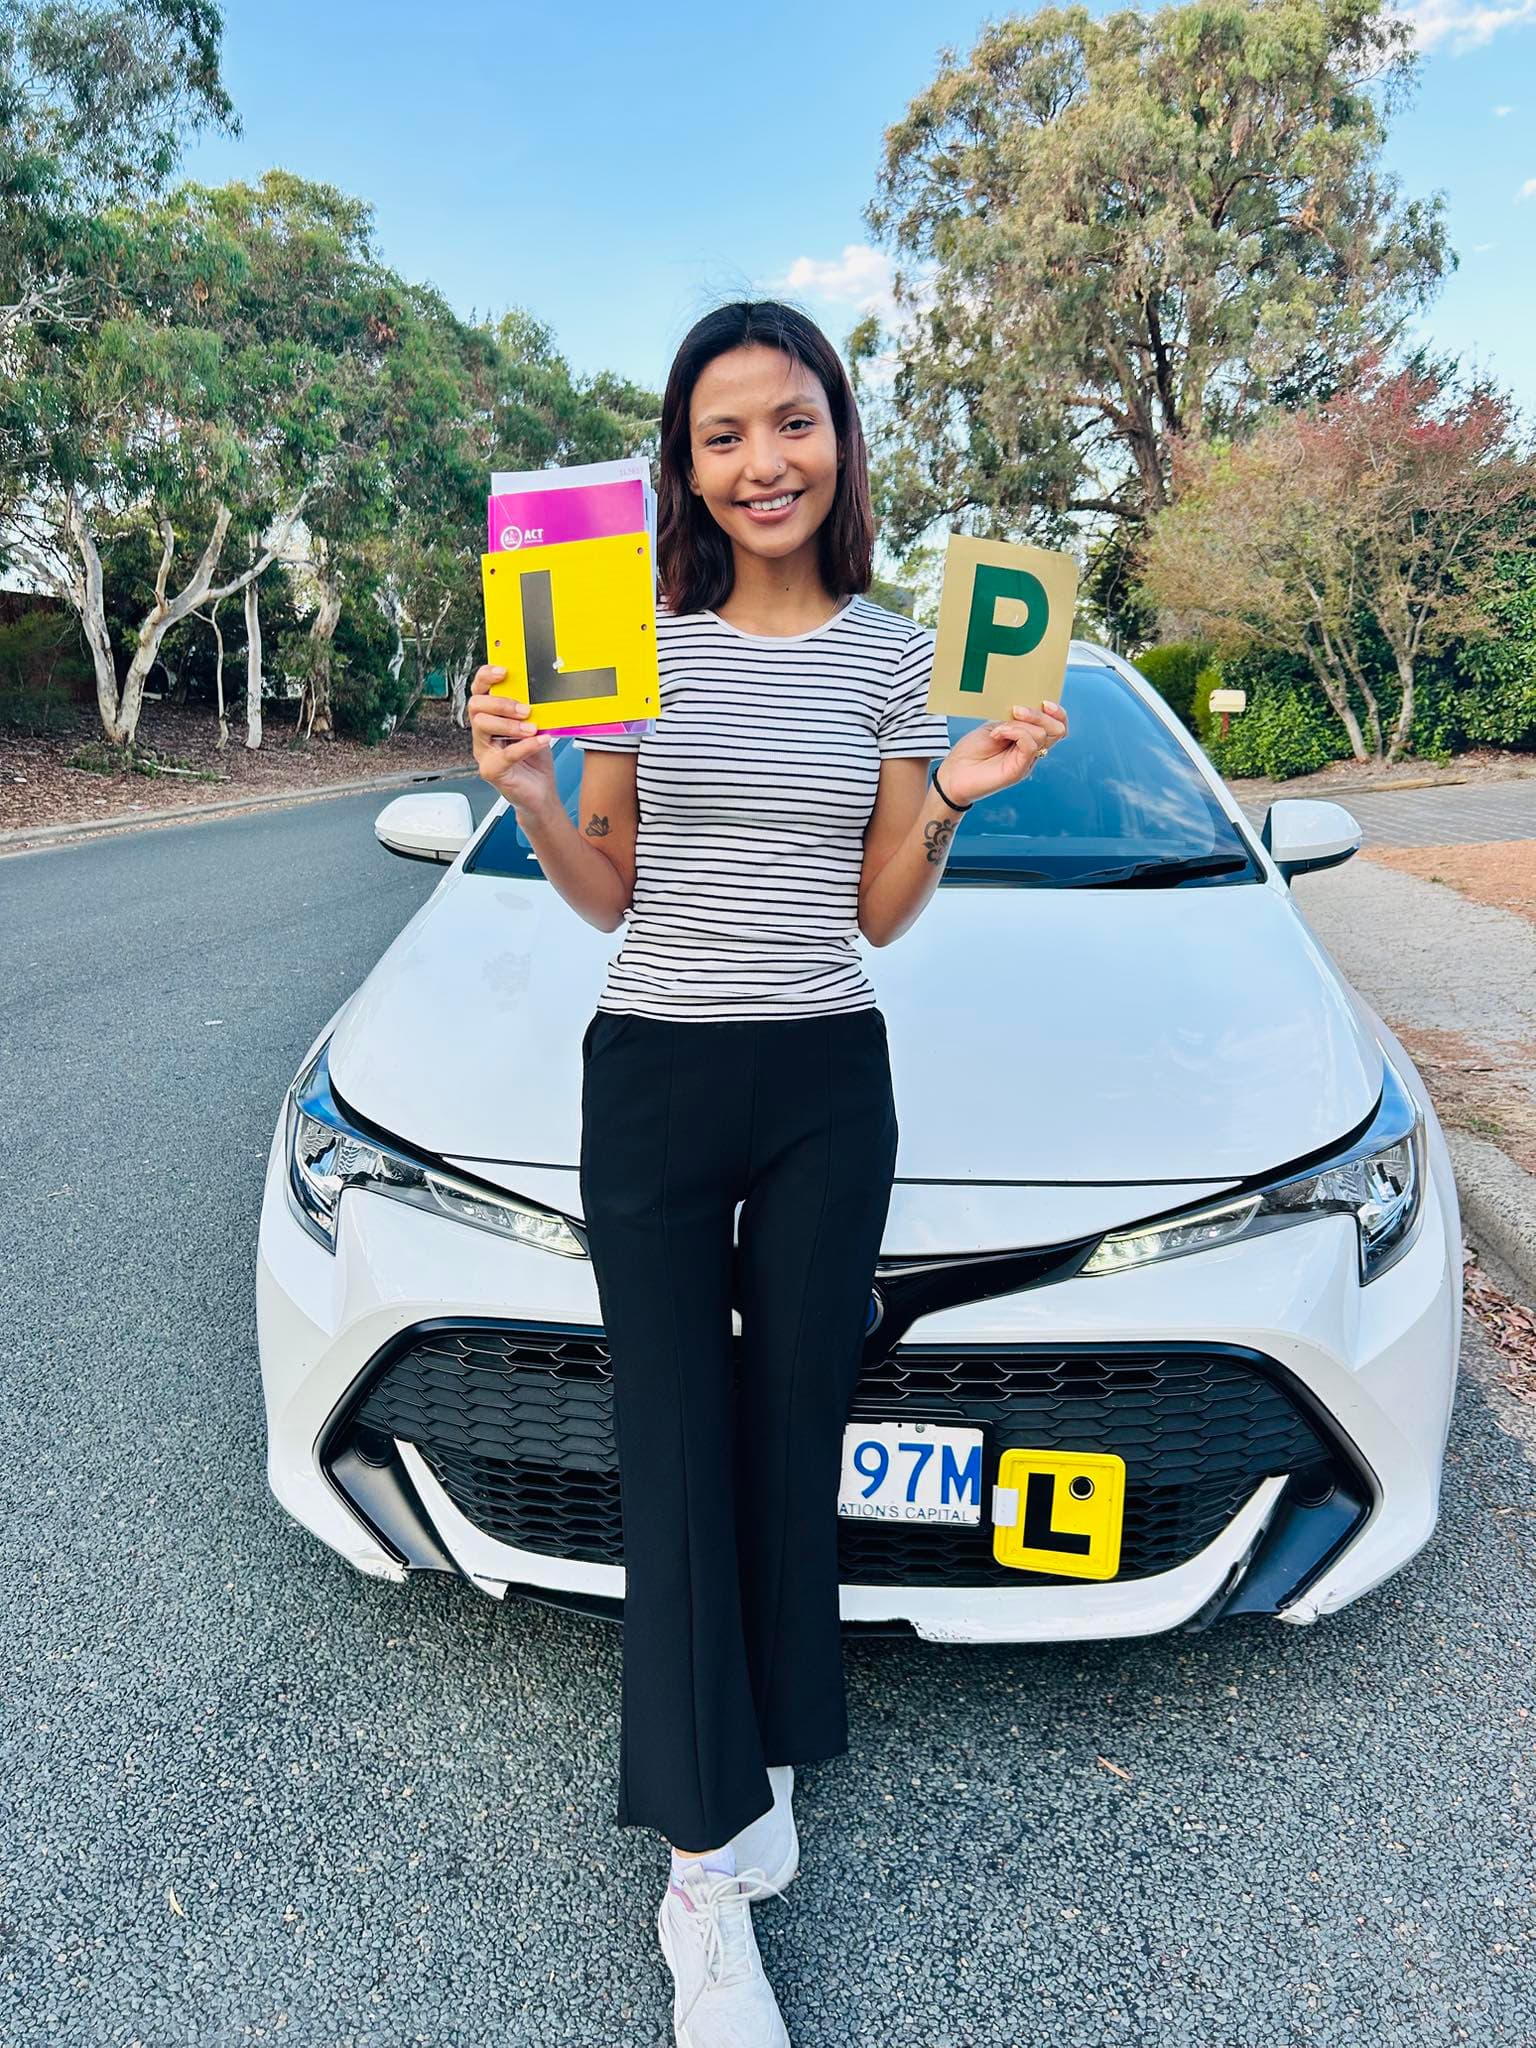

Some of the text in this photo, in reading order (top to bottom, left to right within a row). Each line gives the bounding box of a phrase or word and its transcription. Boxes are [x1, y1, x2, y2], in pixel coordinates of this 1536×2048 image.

[524, 528, 543, 539] ACT
[520, 569, 618, 704] L
[959, 563, 1049, 693] P
[854, 1441, 981, 1505] 97M
[838, 1503, 971, 1521] ATION'S CAPITAL
[1023, 1472, 1091, 1555] L
